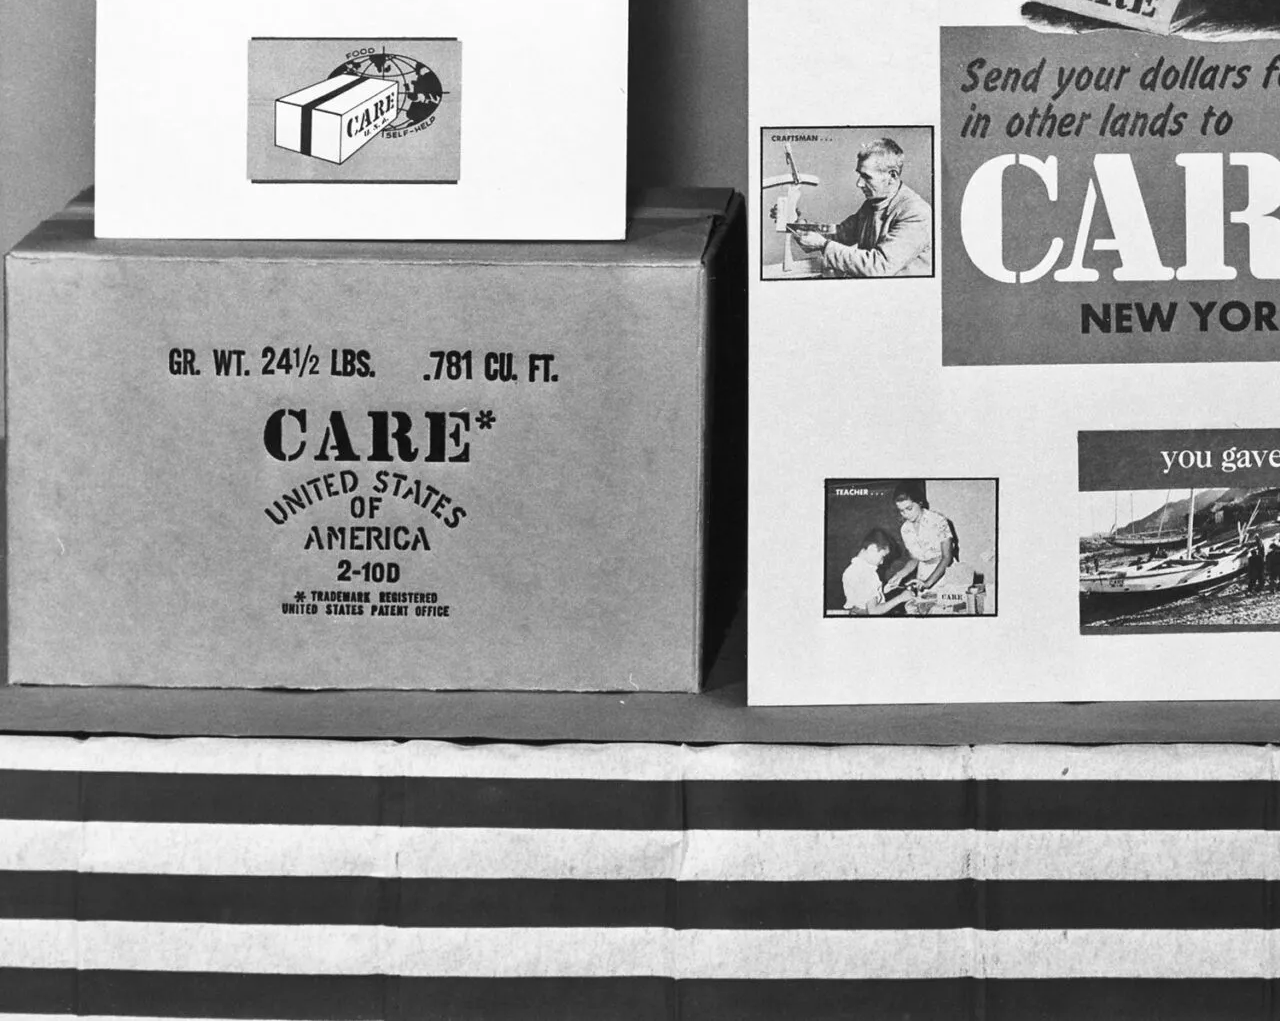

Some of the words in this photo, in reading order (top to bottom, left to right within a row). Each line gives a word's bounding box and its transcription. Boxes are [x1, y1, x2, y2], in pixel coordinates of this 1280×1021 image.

[346, 48, 375, 59] FOOD
[961, 56, 1046, 93] Send
[1053, 63, 1132, 101] your
[1139, 55, 1253, 91] dollars
[346, 92, 396, 138] CARE
[386, 116, 435, 139] SELF-HELP
[961, 103, 990, 138] in
[1006, 103, 1091, 138] other
[1099, 102, 1188, 138] lands
[1201, 106, 1233, 136] to
[1081, 302, 1177, 333] NEW
[169, 348, 200, 375] GR.
[213, 349, 250, 376] WT.
[331, 349, 375, 377] LBS.
[423, 350, 472, 380] .781
[485, 352, 517, 382] CU.
[529, 354, 558, 382] FT.
[1161, 450, 1212, 473] you
[264, 469, 359, 526] UNITED
[371, 469, 468, 529] STATES
[350, 495, 383, 520] OF
[304, 526, 430, 551] AMERICA
[311, 590, 371, 602] TRADEMARK
[379, 591, 438, 603] REGISTERED
[281, 603, 318, 616] UNITED
[325, 604, 364, 617] STATES
[371, 605, 409, 618] PATENT
[415, 605, 450, 618] OFFICE
